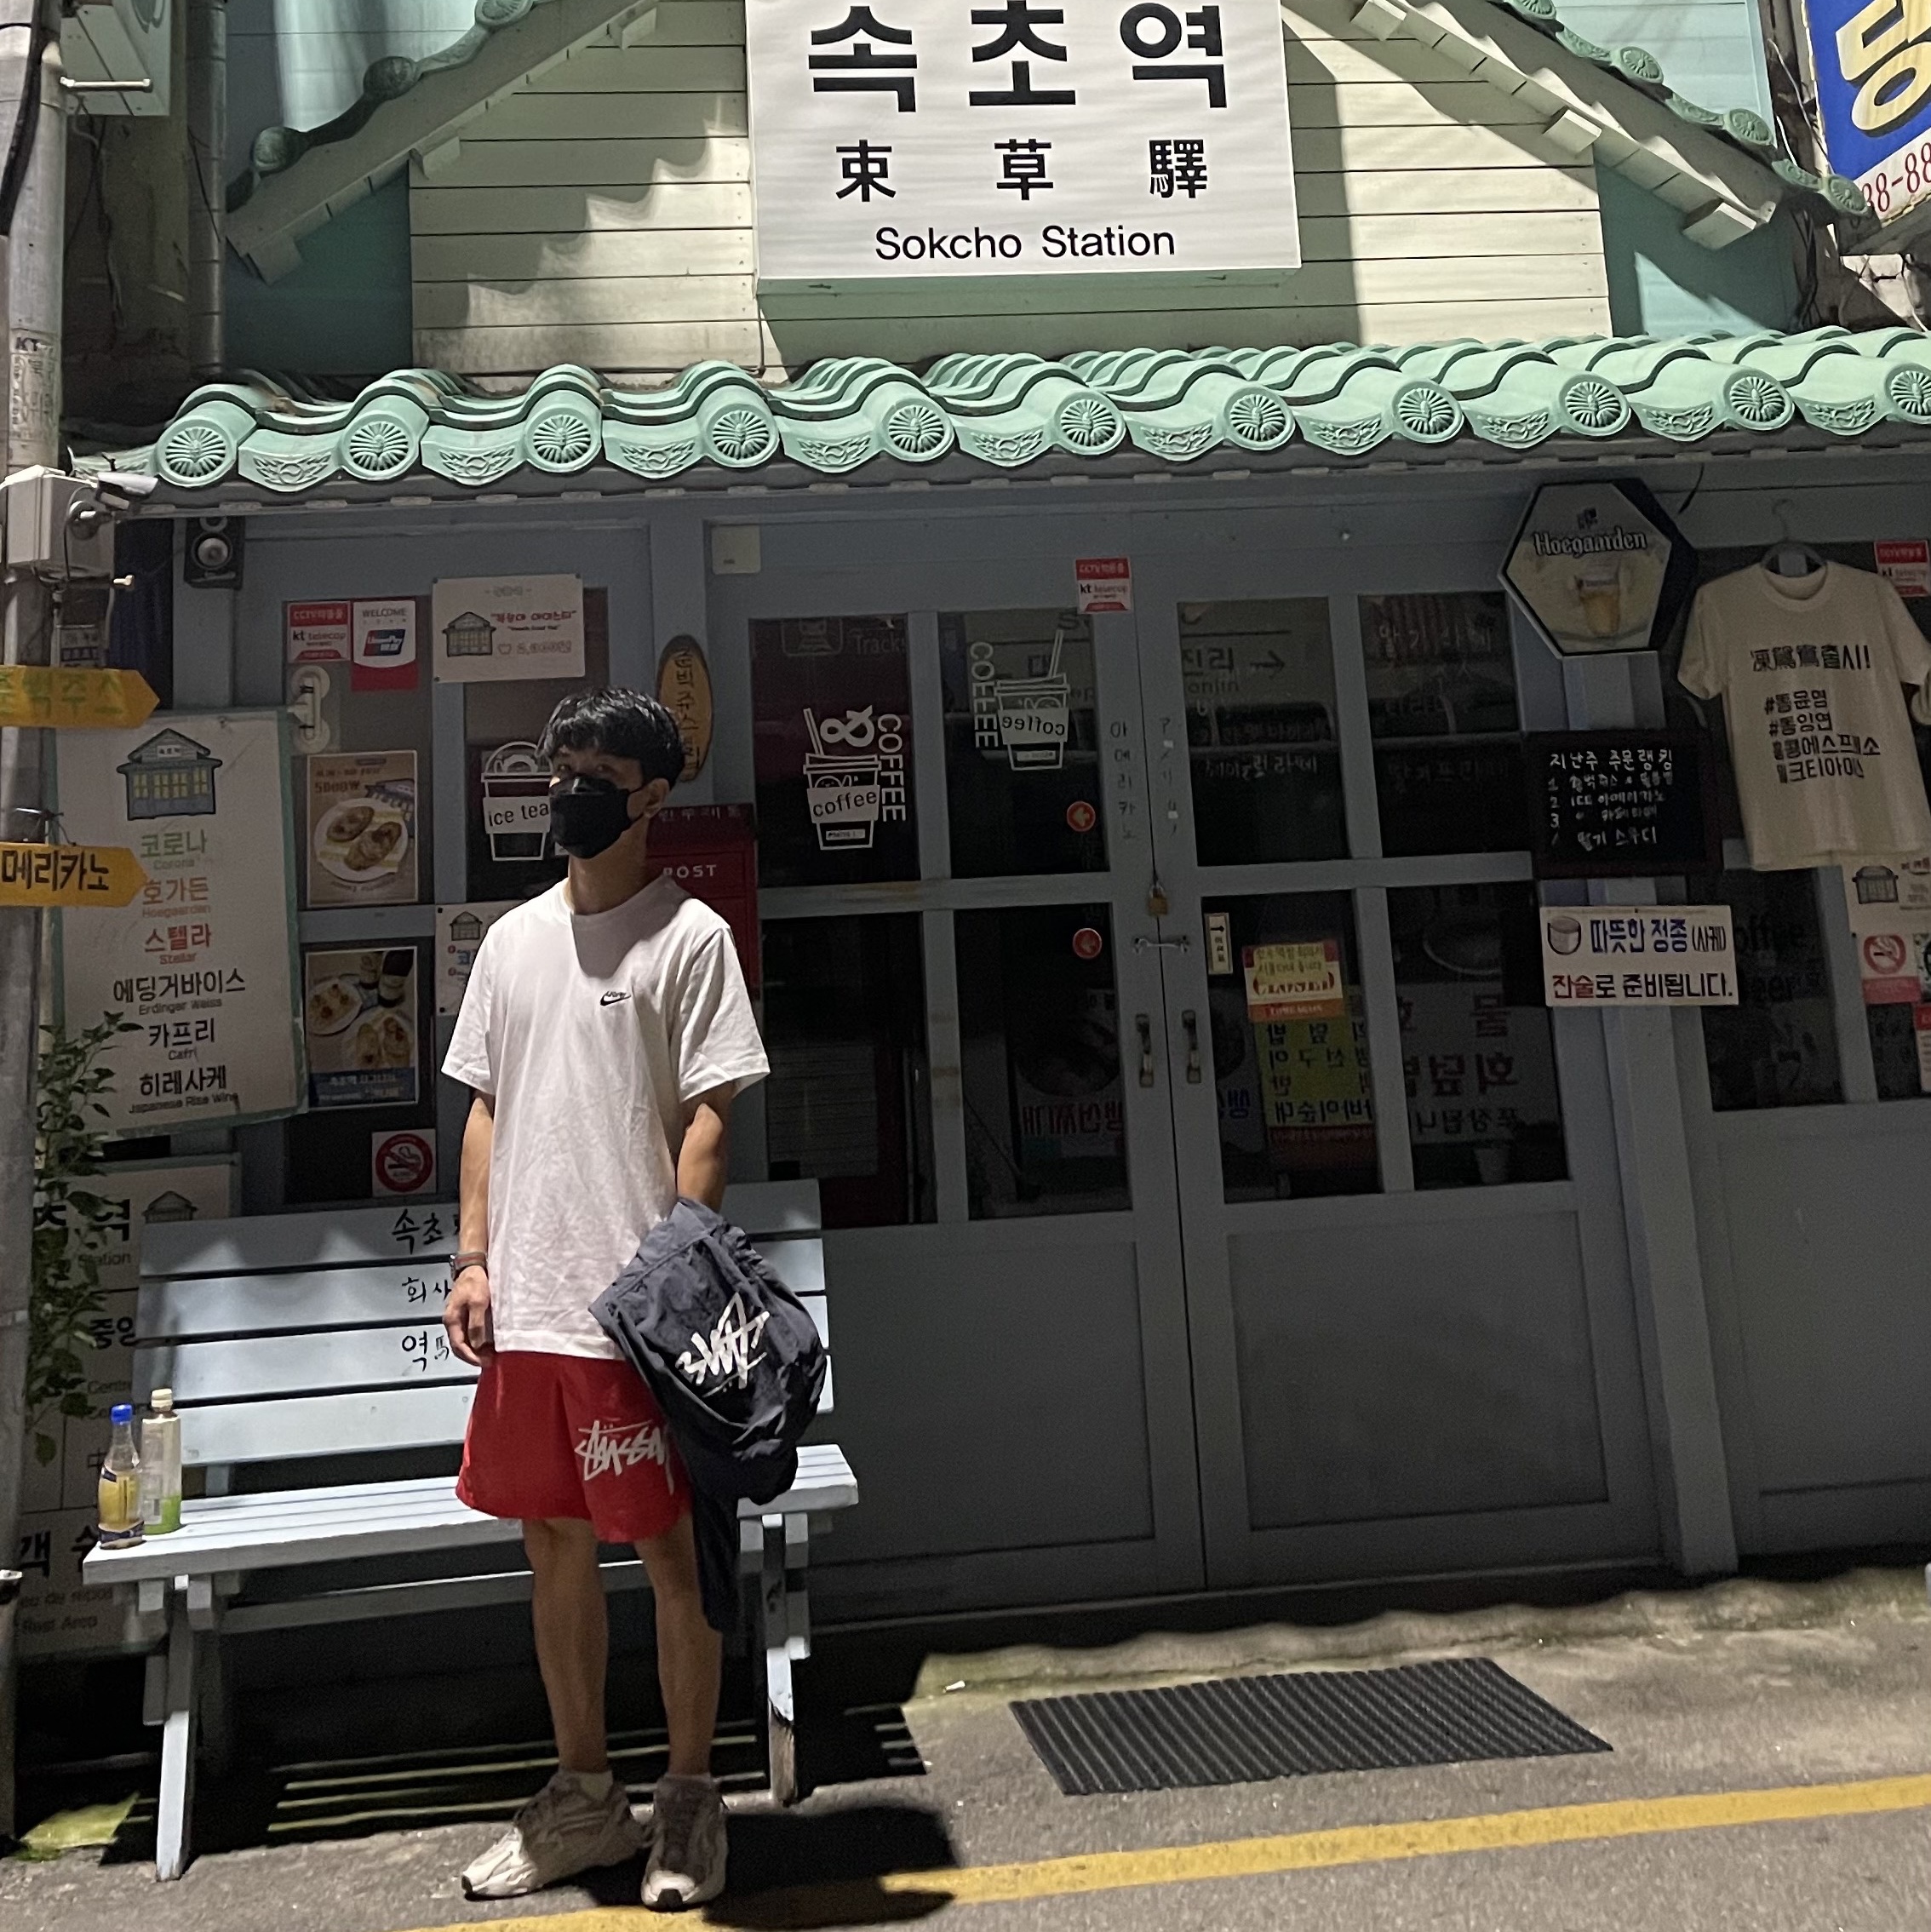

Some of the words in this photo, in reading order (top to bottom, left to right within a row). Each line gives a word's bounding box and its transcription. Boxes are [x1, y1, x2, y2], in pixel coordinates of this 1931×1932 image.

[808, 0, 1227, 112] 속초역
[835, 139, 1208, 202] 束草驛
[875, 226, 1022, 260] Sokcho
[1041, 225, 1175, 256] Station
[1533, 526, 1647, 559] Hoegaarden
[1080, 583, 1092, 593] kt
[362, 607, 408, 618] WELCOME
[293, 630, 305, 640] kt
[877, 714, 906, 822] COFFEE
[1550, 750, 1598, 771] 지난주
[1609, 749, 1636, 771] 주문
[489, 809, 514, 827] ice
[521, 800, 550, 820] tea
[812, 790, 877, 817] coffee
[1550, 796, 1560, 808] 2
[1550, 812, 1560, 828] 3
[140, 829, 207, 858] 코로나
[663, 864, 716, 878] POST
[142, 877, 209, 905] 호가든
[144, 924, 212, 952] 스텔라
[1590, 918, 1645, 954] 따뜻한
[1651, 918, 1687, 954] 정종
[113, 968, 246, 1003] 에딩거바이스
[1552, 974, 1617, 999] 잔술로
[1623, 972, 1733, 998] 준비됩니다.
[148, 1018, 216, 1048] 카프리
[139, 1064, 226, 1098] 히레사케
